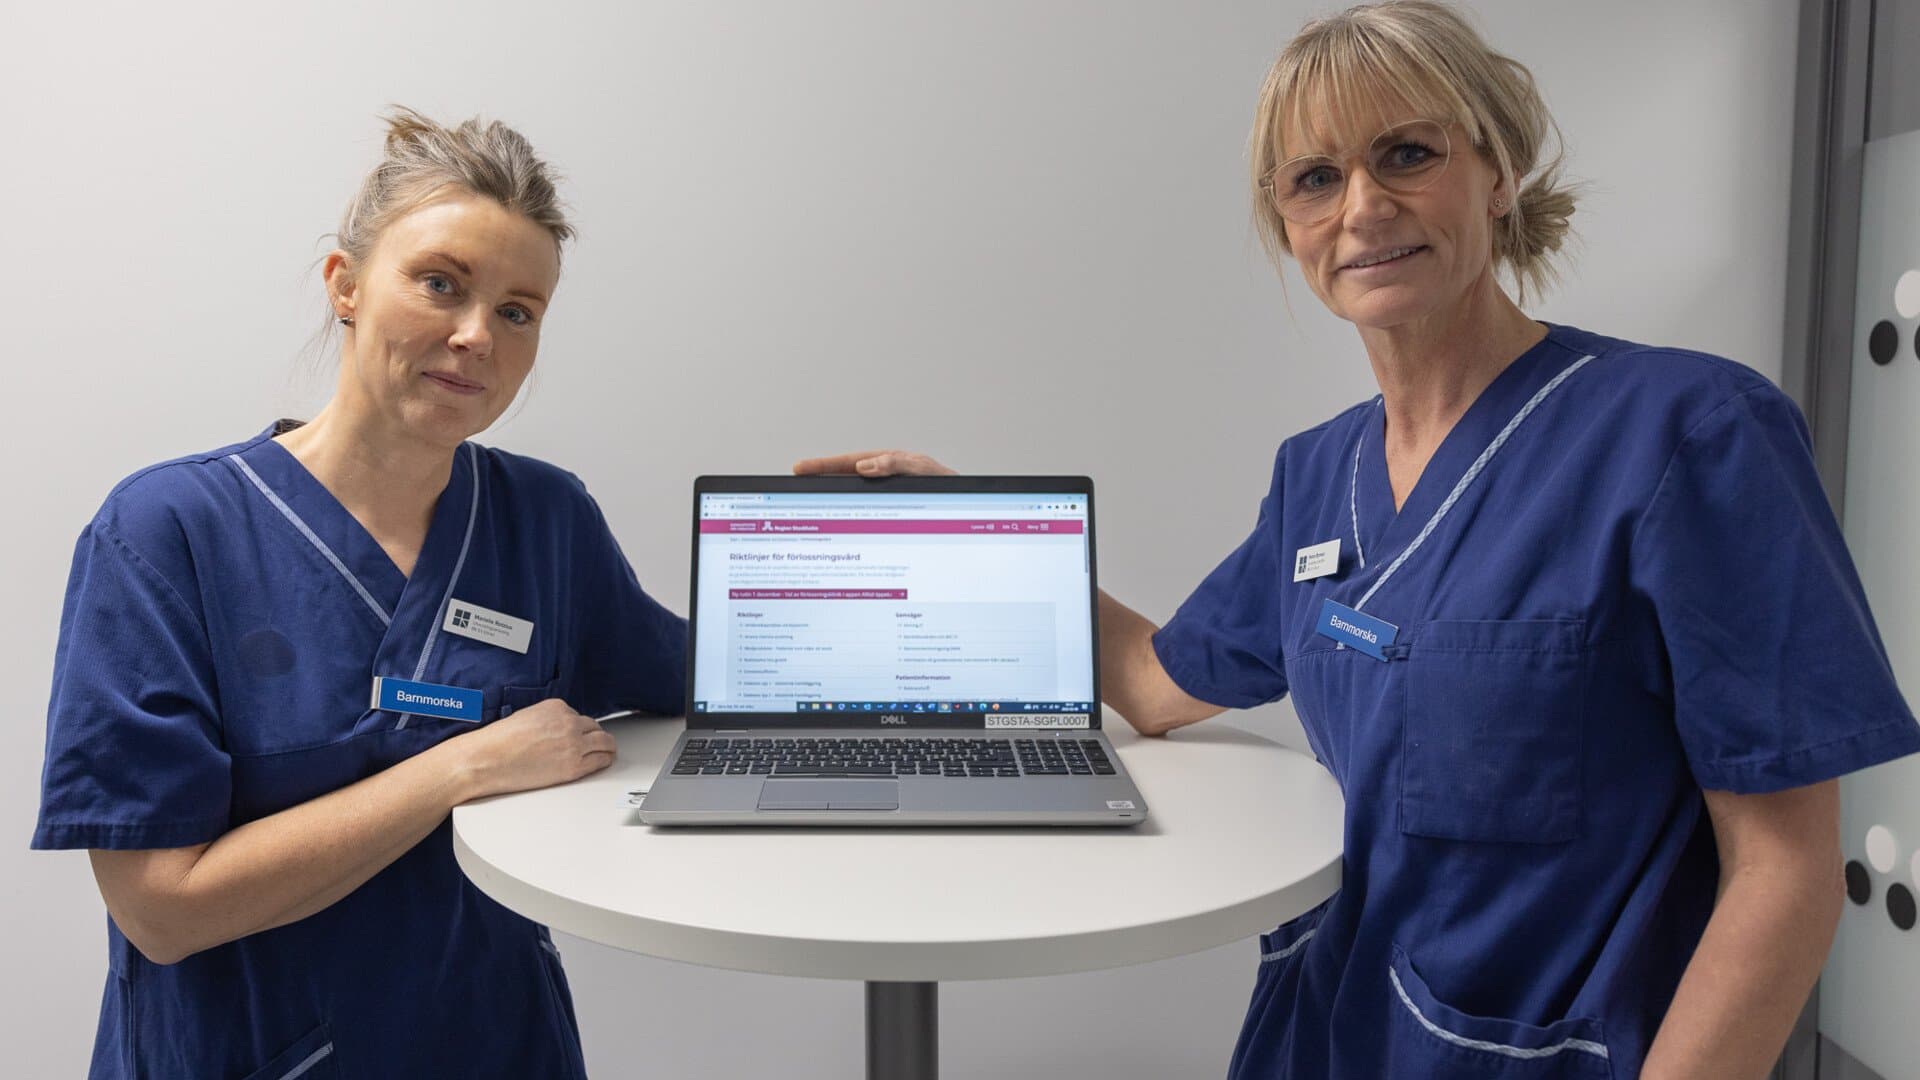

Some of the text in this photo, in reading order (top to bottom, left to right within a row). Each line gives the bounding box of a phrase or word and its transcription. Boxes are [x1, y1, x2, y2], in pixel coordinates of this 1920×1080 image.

[729, 553, 861, 563] Riktlinjer för förlossningsvård
[1330, 615, 1377, 643] Barnmorska
[396, 690, 463, 709] Barnmorska
[881, 715, 907, 725] DELL
[987, 715, 1088, 727] STGSTA-SGPL0007
